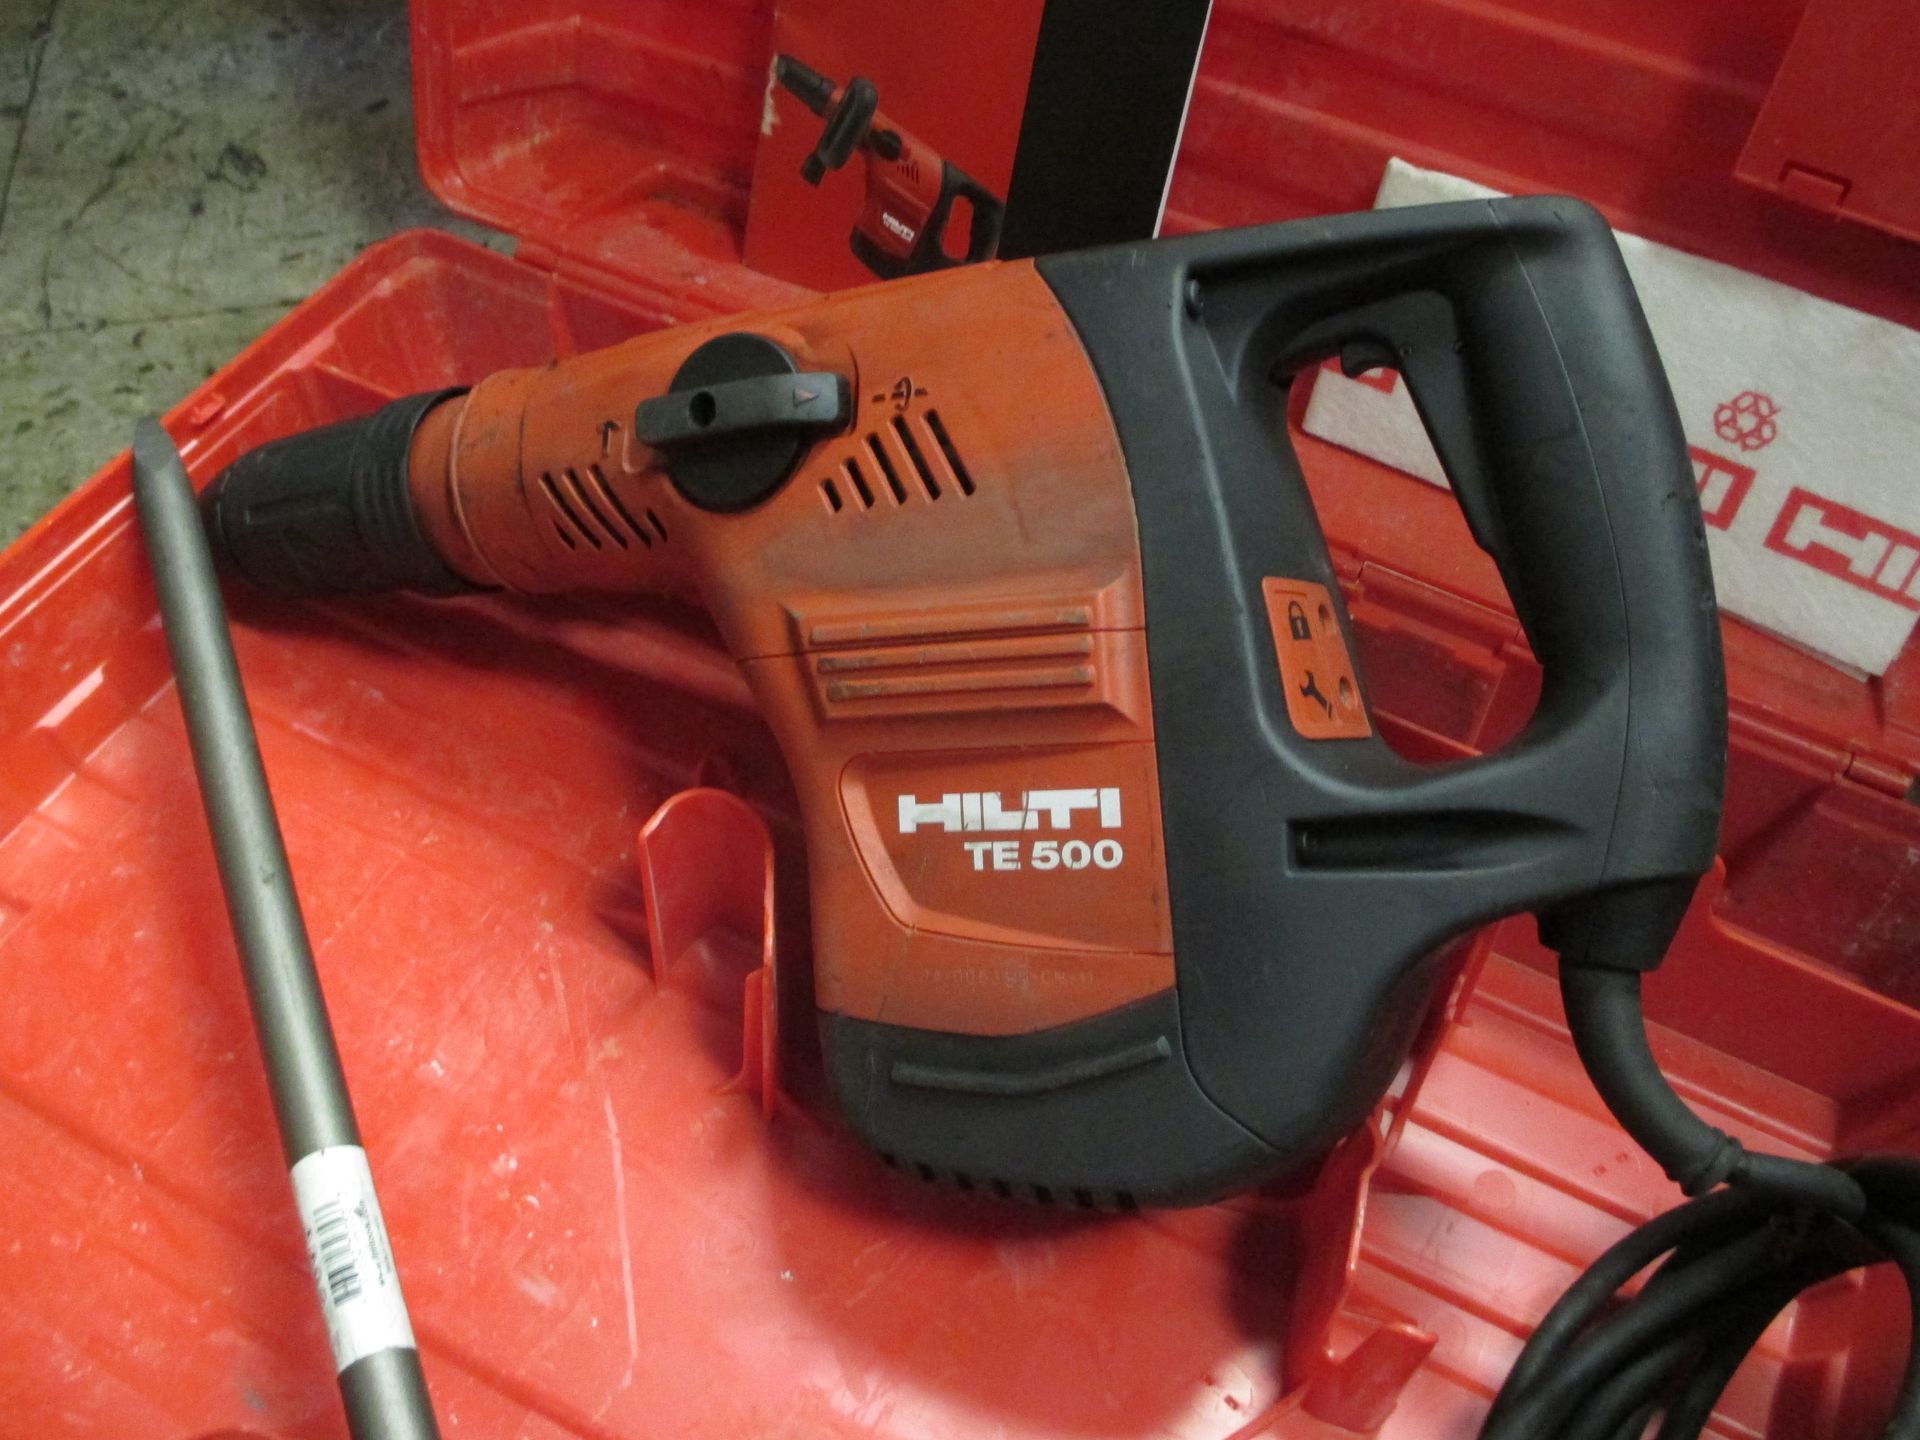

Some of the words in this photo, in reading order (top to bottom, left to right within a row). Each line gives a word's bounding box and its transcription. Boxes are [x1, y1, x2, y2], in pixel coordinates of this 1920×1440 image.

[898, 788, 1121, 833] HILTI
[964, 841, 1021, 870] TE
[1031, 839, 1123, 870] 500
